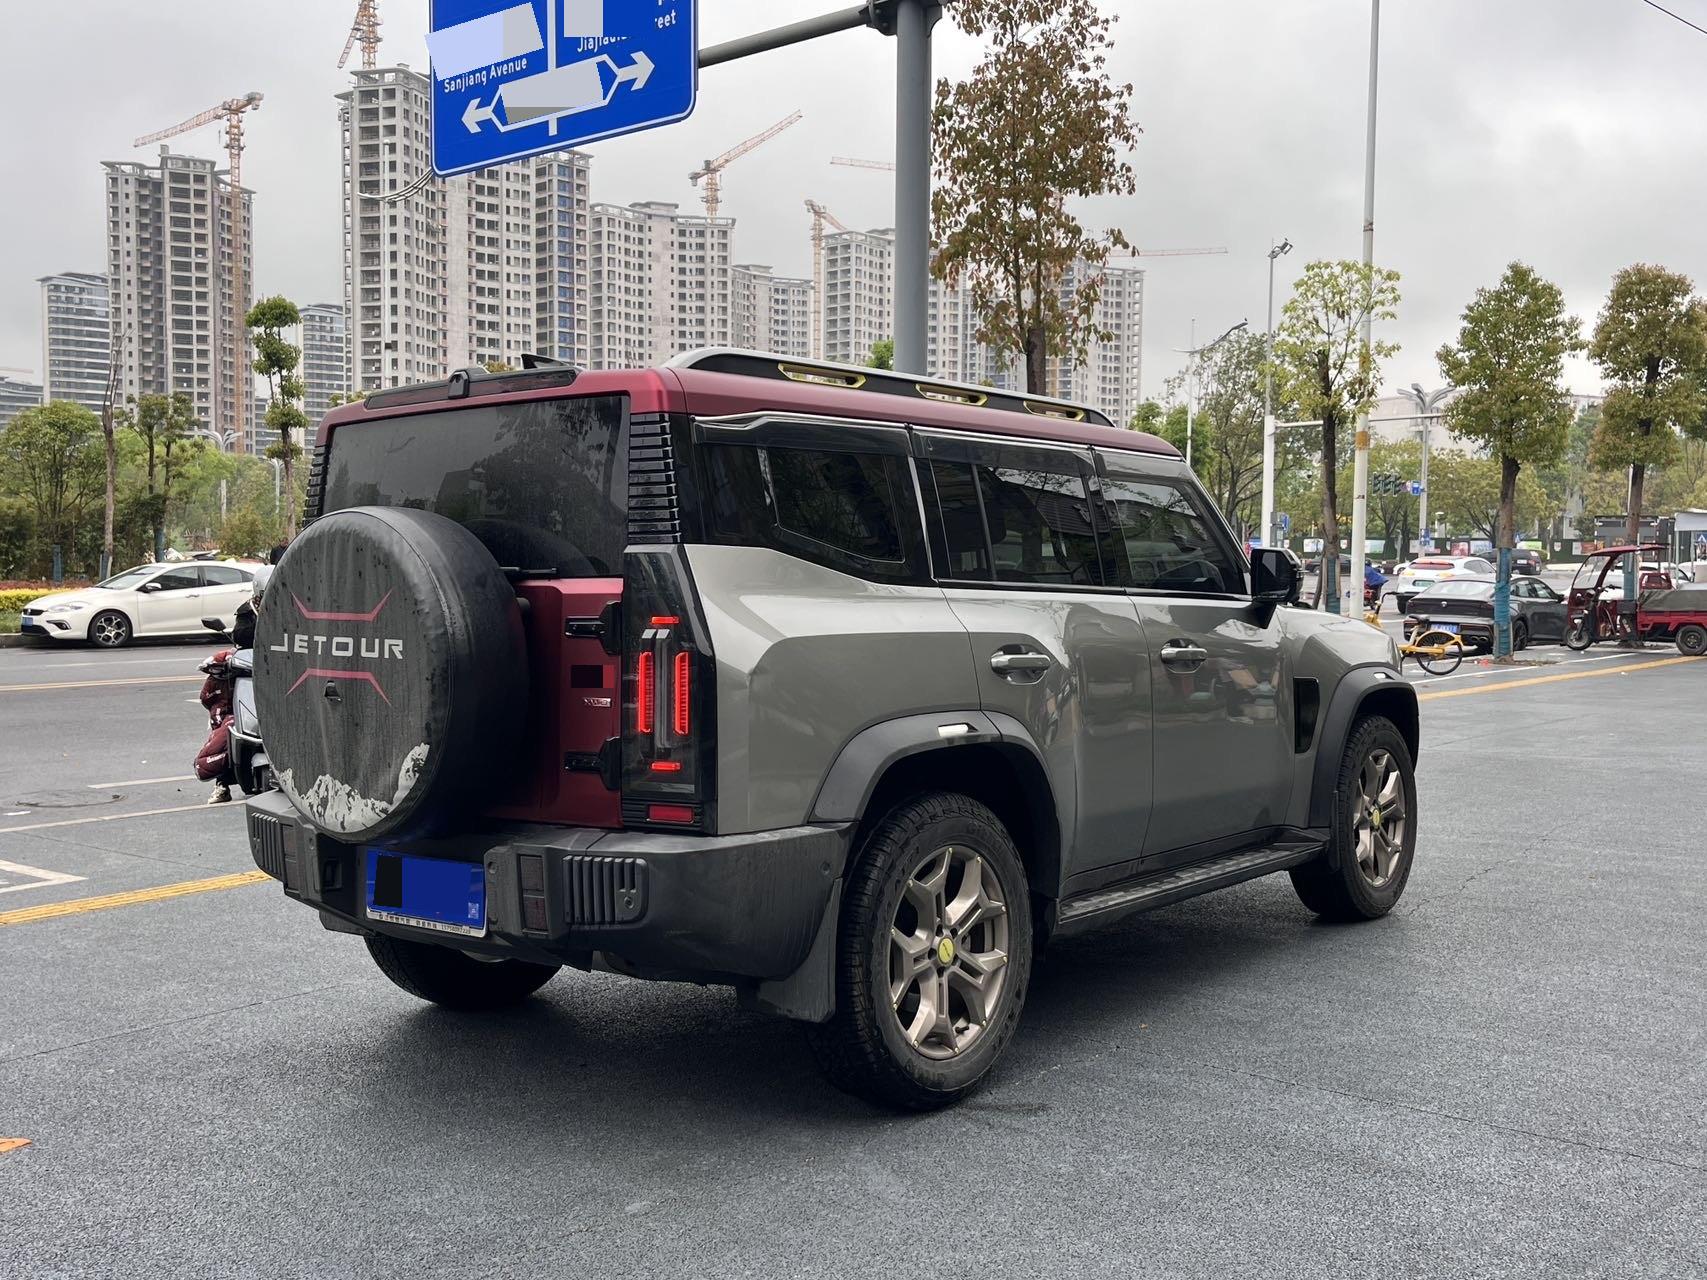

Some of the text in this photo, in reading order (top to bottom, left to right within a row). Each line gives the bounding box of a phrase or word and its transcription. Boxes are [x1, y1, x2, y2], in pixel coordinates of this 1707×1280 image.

[444, 57, 528, 93] Sanjiang Avenue
[270, 633, 404, 660] JETOUR
